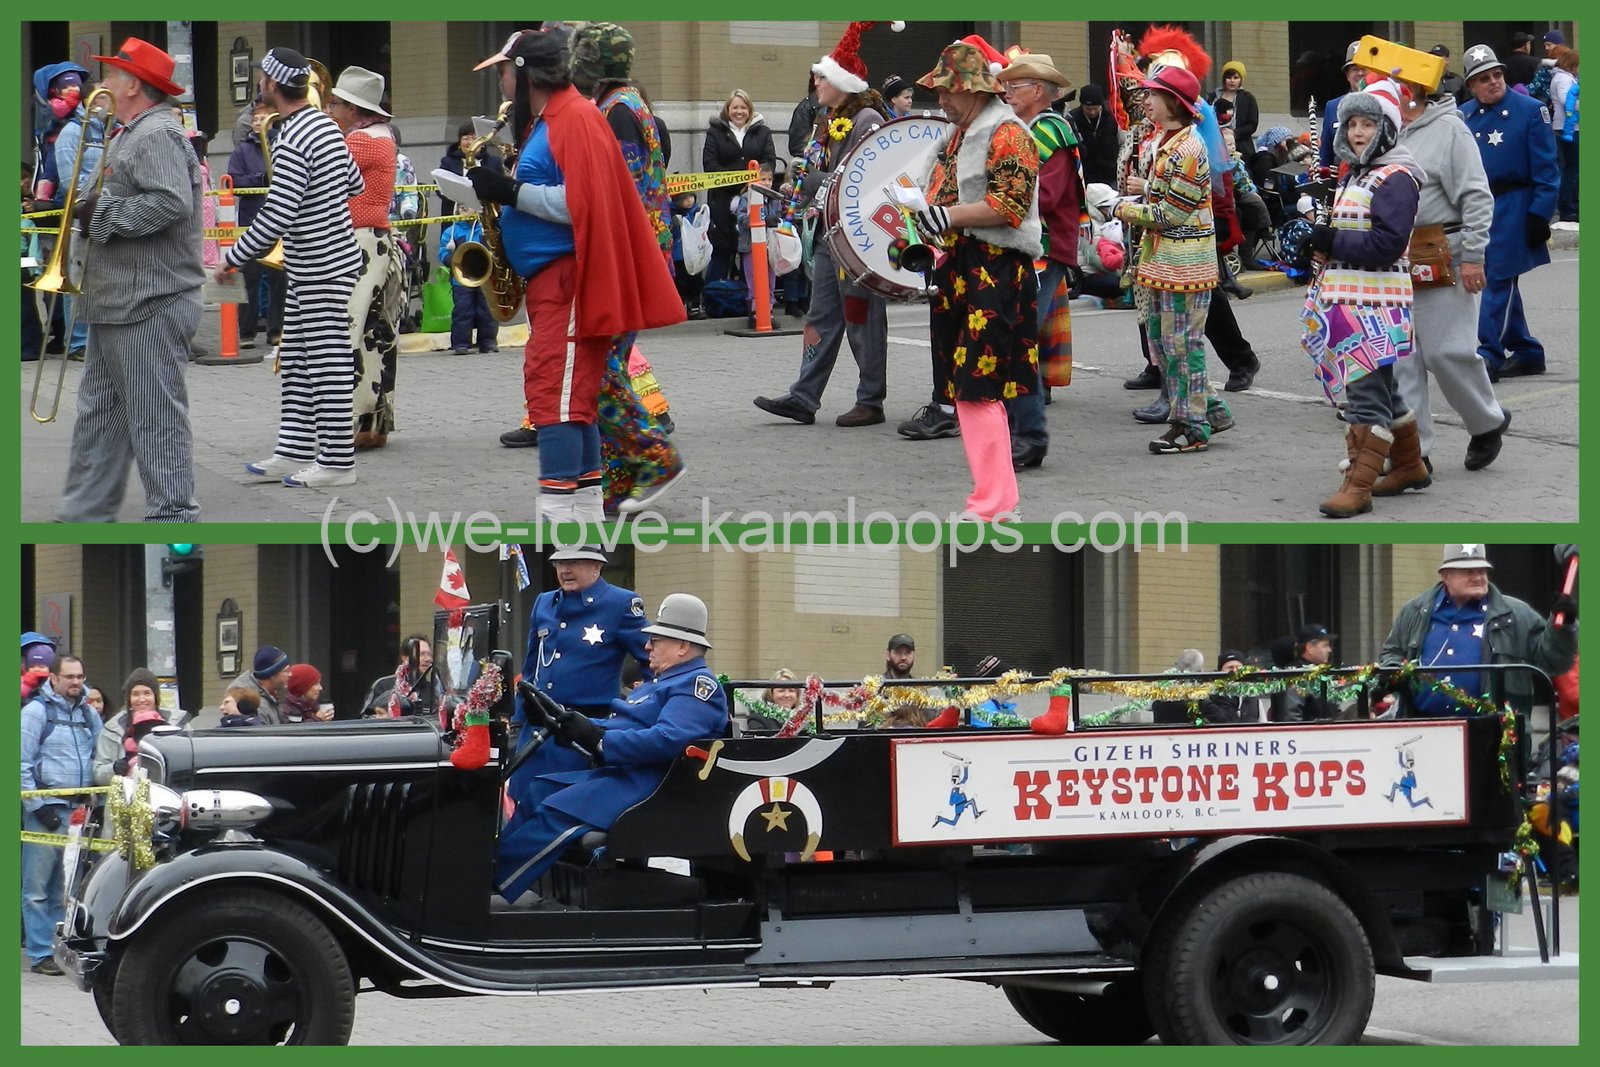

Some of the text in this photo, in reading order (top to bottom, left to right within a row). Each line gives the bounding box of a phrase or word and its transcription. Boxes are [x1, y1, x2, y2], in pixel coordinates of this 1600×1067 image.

[668, 182, 705, 194] AUTION
[714, 172, 758, 186] CAUTION
[845, 147, 877, 252] KAMLOOPS
[876, 129, 902, 151] BC
[1074, 740, 1297, 762] GIZEH SHRINERS
[1013, 759, 1367, 821] KEYSTONE KOPS
[1100, 808, 1184, 821] KAMLOOPS,
